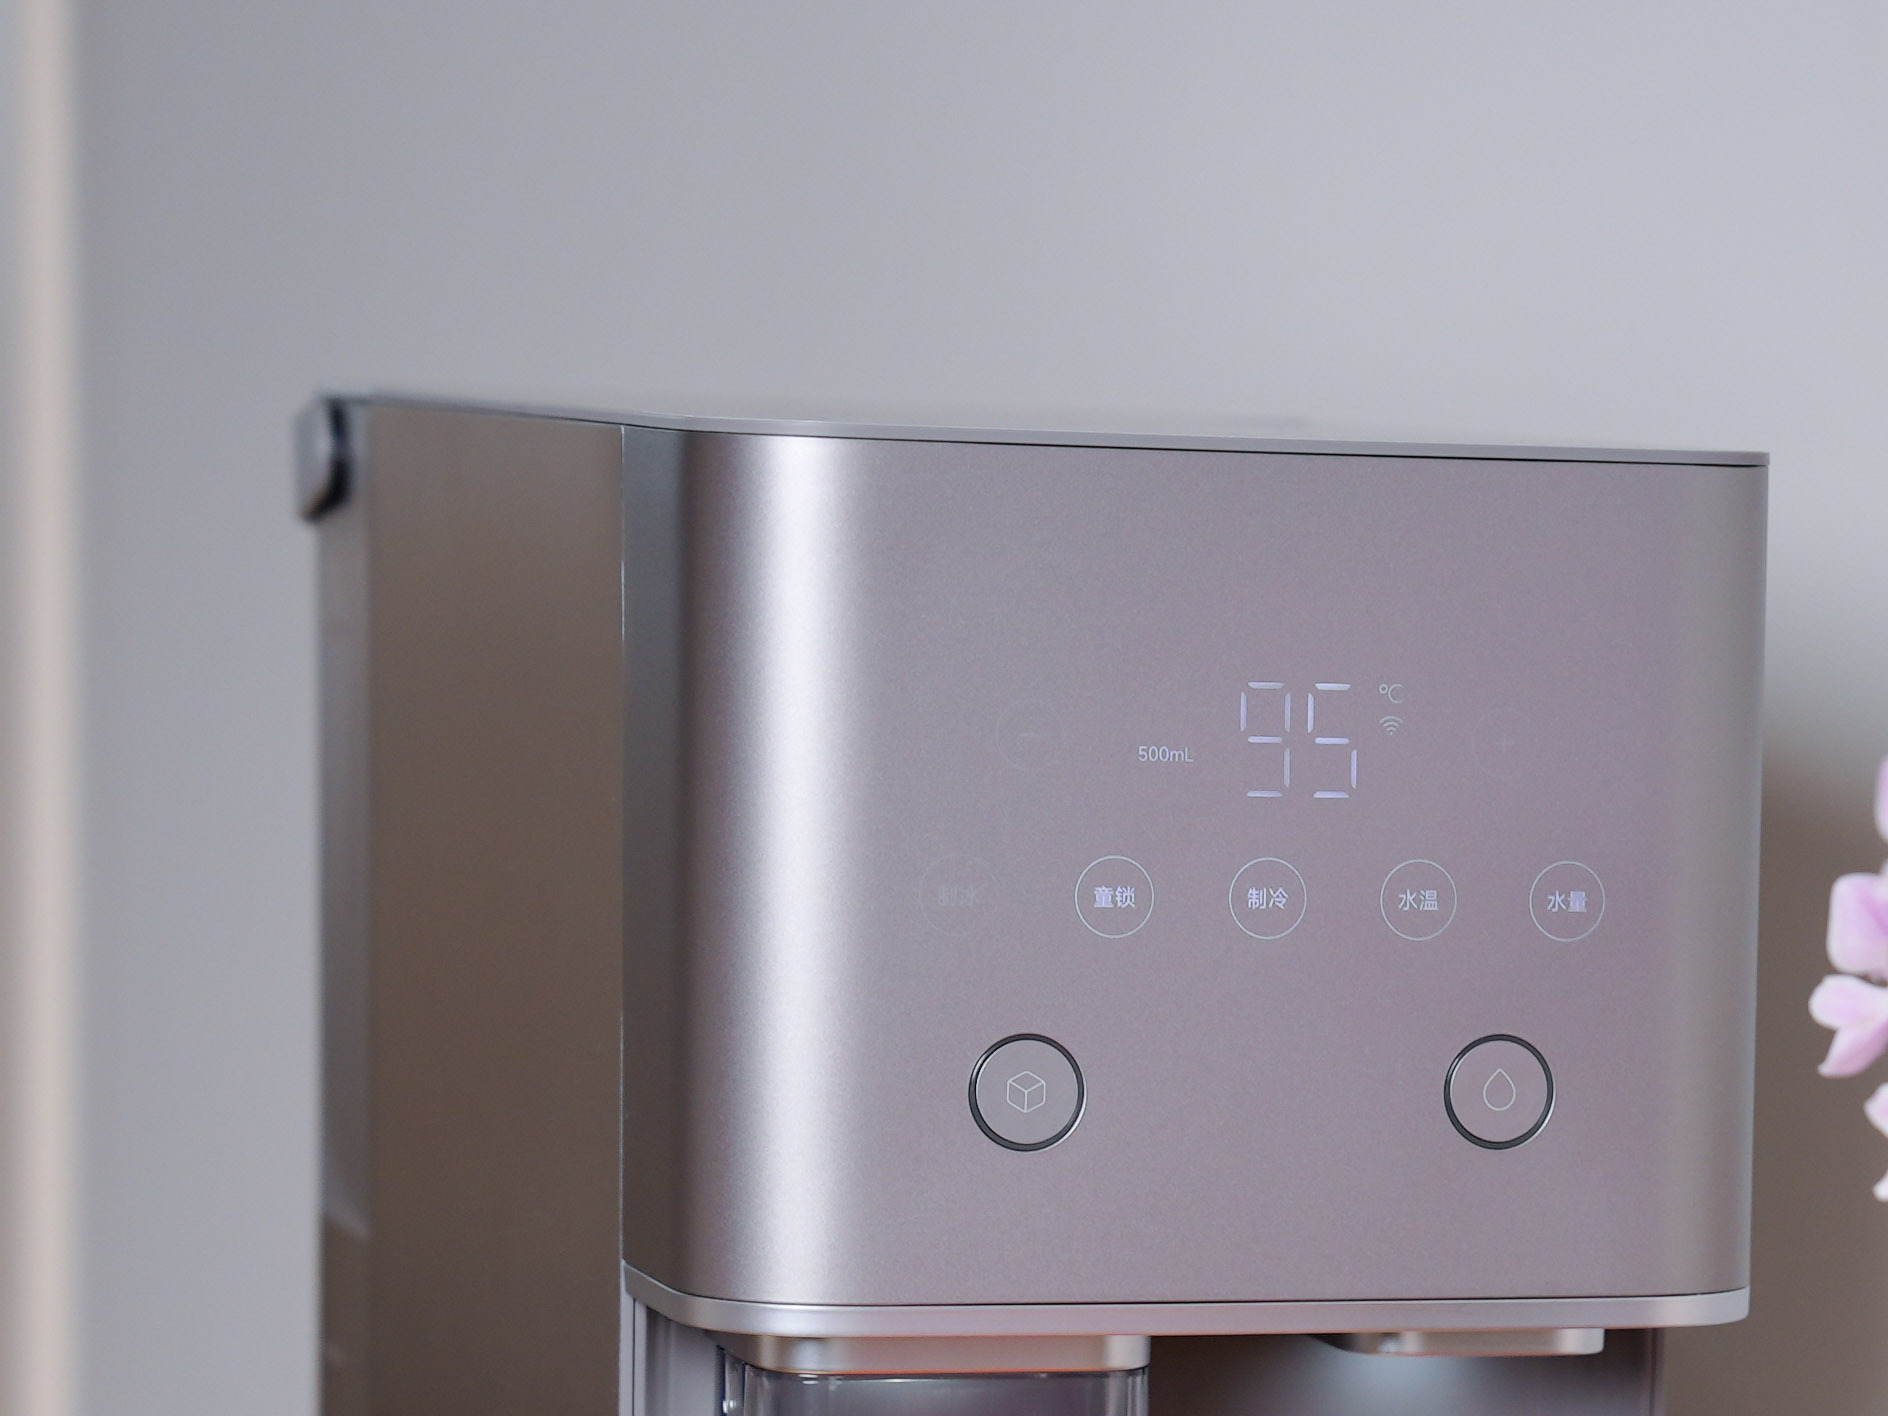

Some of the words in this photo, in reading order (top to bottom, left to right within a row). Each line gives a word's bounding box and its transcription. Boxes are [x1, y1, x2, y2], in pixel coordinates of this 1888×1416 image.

[1240, 681, 1358, 799] 95
[1137, 745, 1194, 763] 500mL
[1093, 885, 1136, 909] 童锁
[1247, 887, 1289, 911] 制冷
[1398, 888, 1440, 912] 水温
[1547, 890, 1588, 913] 水量
